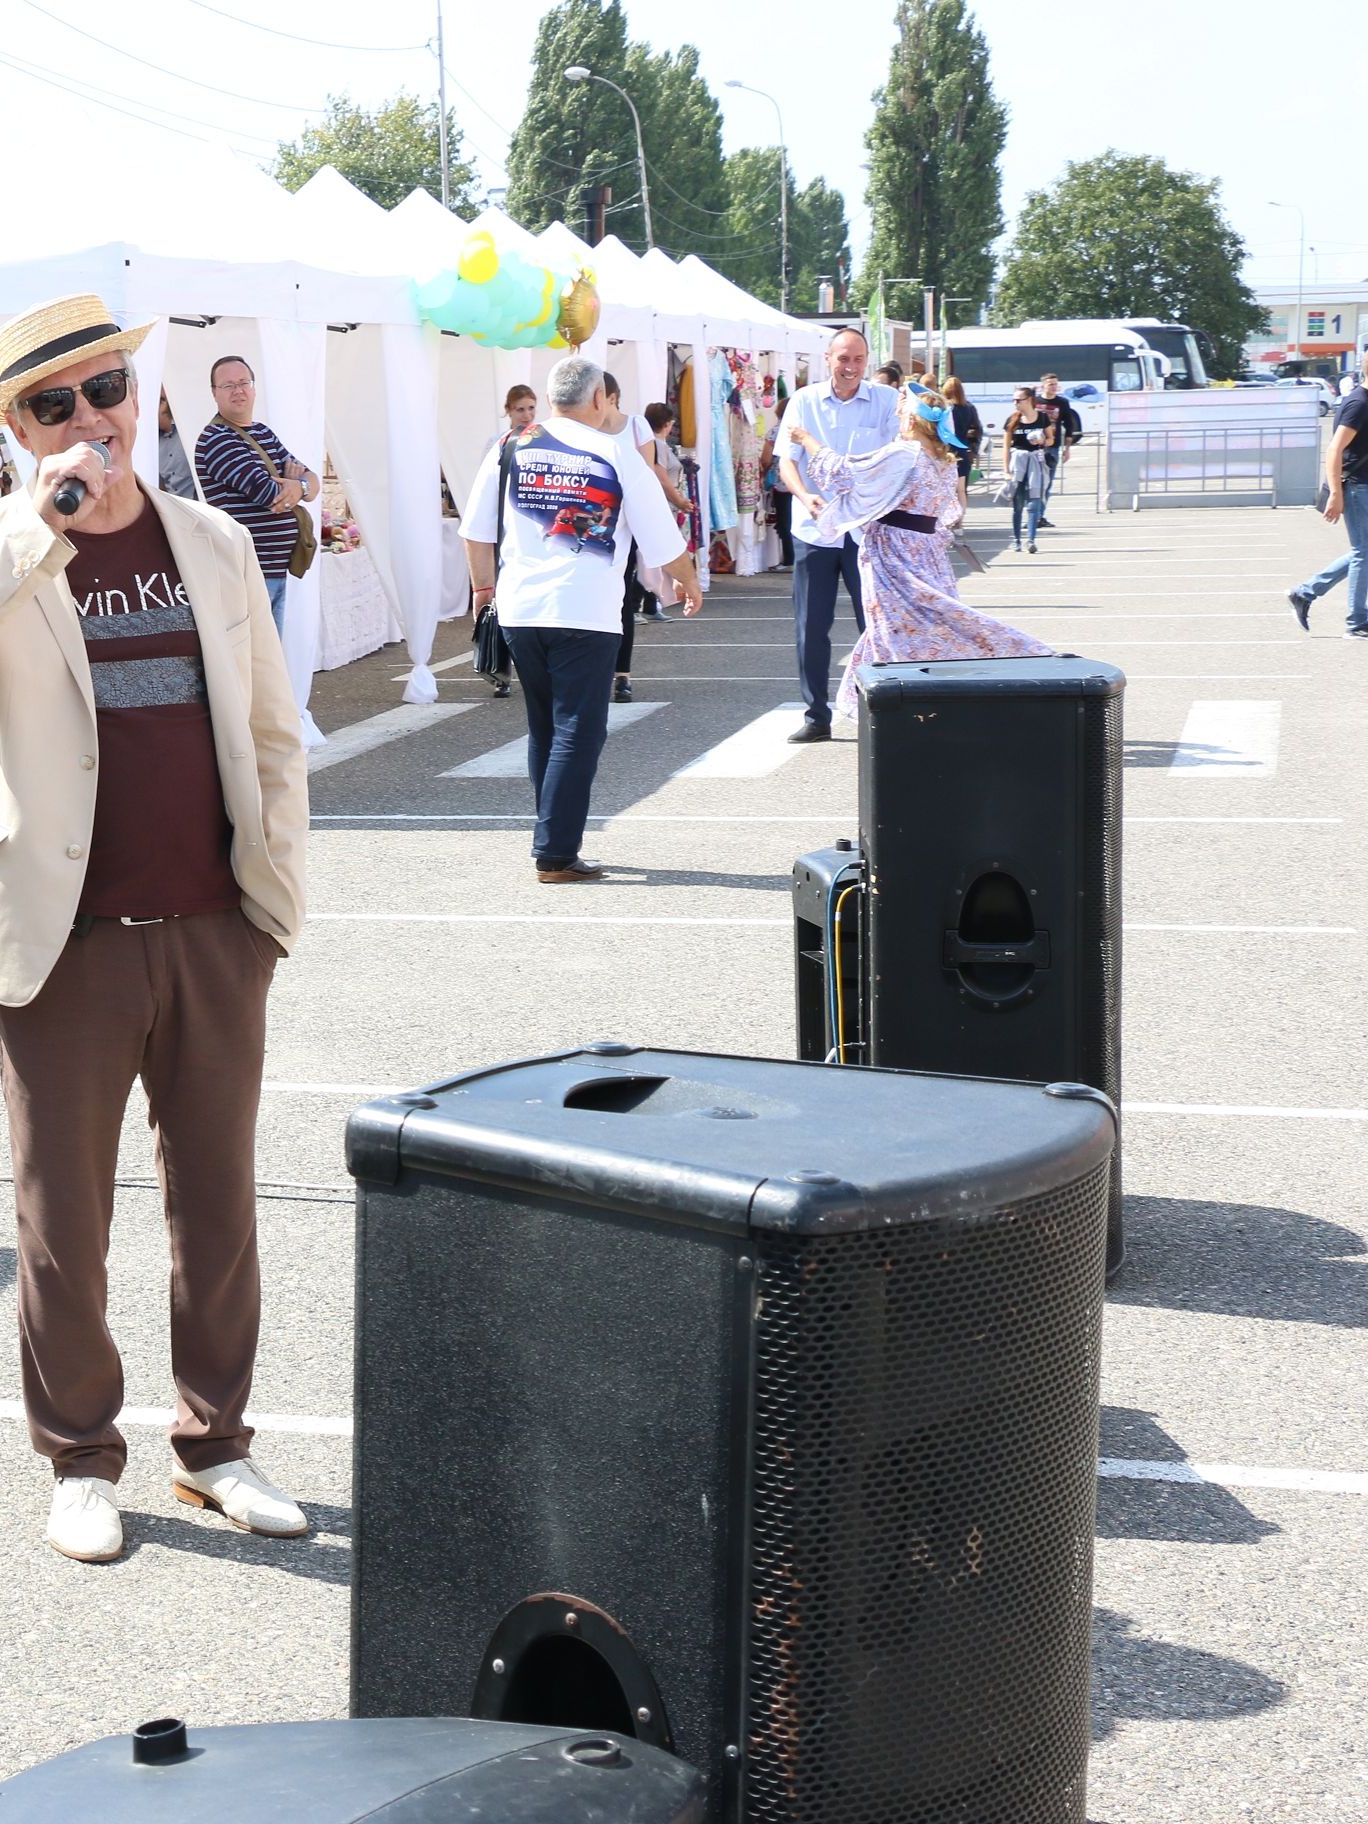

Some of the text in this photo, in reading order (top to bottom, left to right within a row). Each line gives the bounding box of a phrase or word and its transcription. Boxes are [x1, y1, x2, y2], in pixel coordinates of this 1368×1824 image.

[1331, 314, 1341, 334] 1
[520, 463, 548, 472] СРЕДИ
[518, 472, 590, 488] ПО БОКСУ
